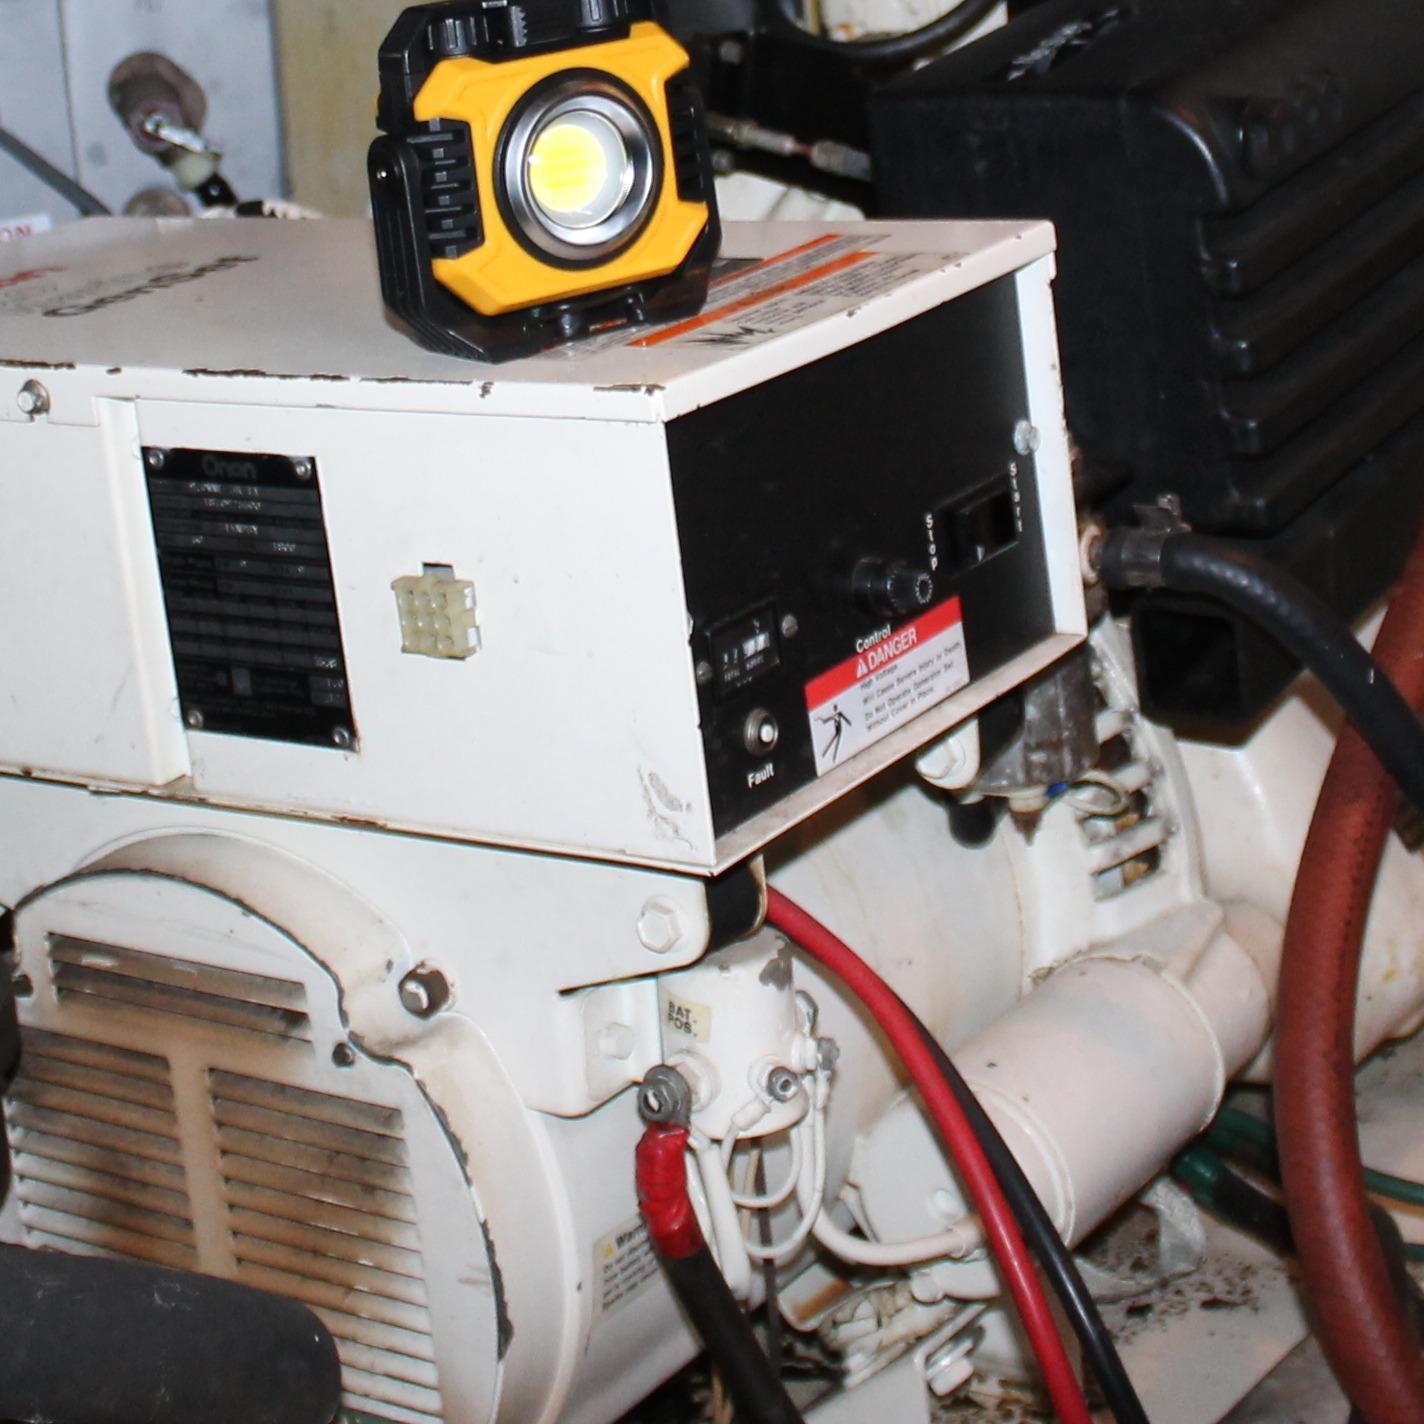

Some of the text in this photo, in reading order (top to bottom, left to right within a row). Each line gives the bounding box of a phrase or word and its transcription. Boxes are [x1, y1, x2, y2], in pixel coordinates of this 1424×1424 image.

[1008, 461, 1023, 533] Start
[924, 513, 938, 572] Stop
[855, 623, 892, 654] Control
[867, 627, 918, 670] DANGER
[746, 763, 776, 790] Fault
